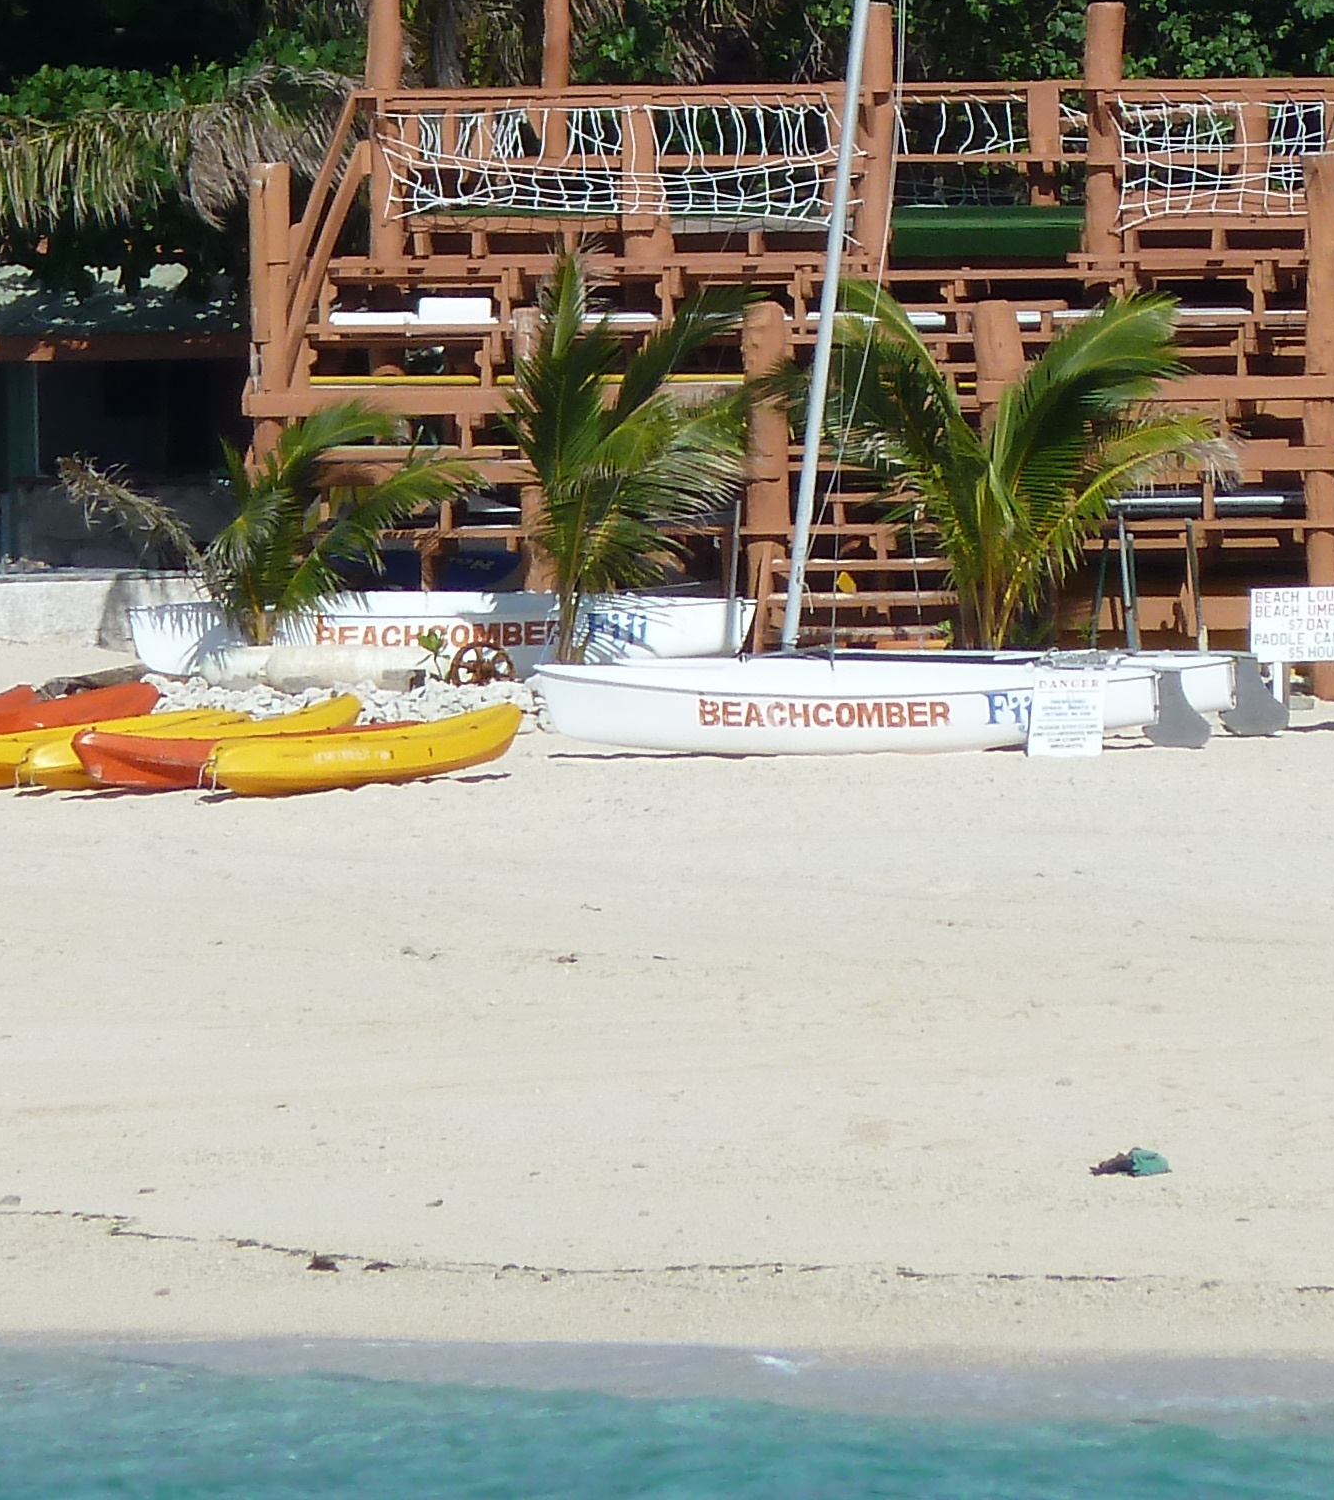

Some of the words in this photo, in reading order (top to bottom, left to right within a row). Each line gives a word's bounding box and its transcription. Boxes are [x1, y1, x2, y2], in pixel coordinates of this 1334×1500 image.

[1255, 590, 1300, 603] BEACH
[1255, 605, 1300, 618] BEACH
[1306, 618, 1331, 631] DAY
[1254, 633, 1305, 645] PADDLE
[1038, 679, 1099, 689] DANGER
[699, 699, 951, 728] BEACHCOMBER
[980, 691, 1032, 732] Fij
